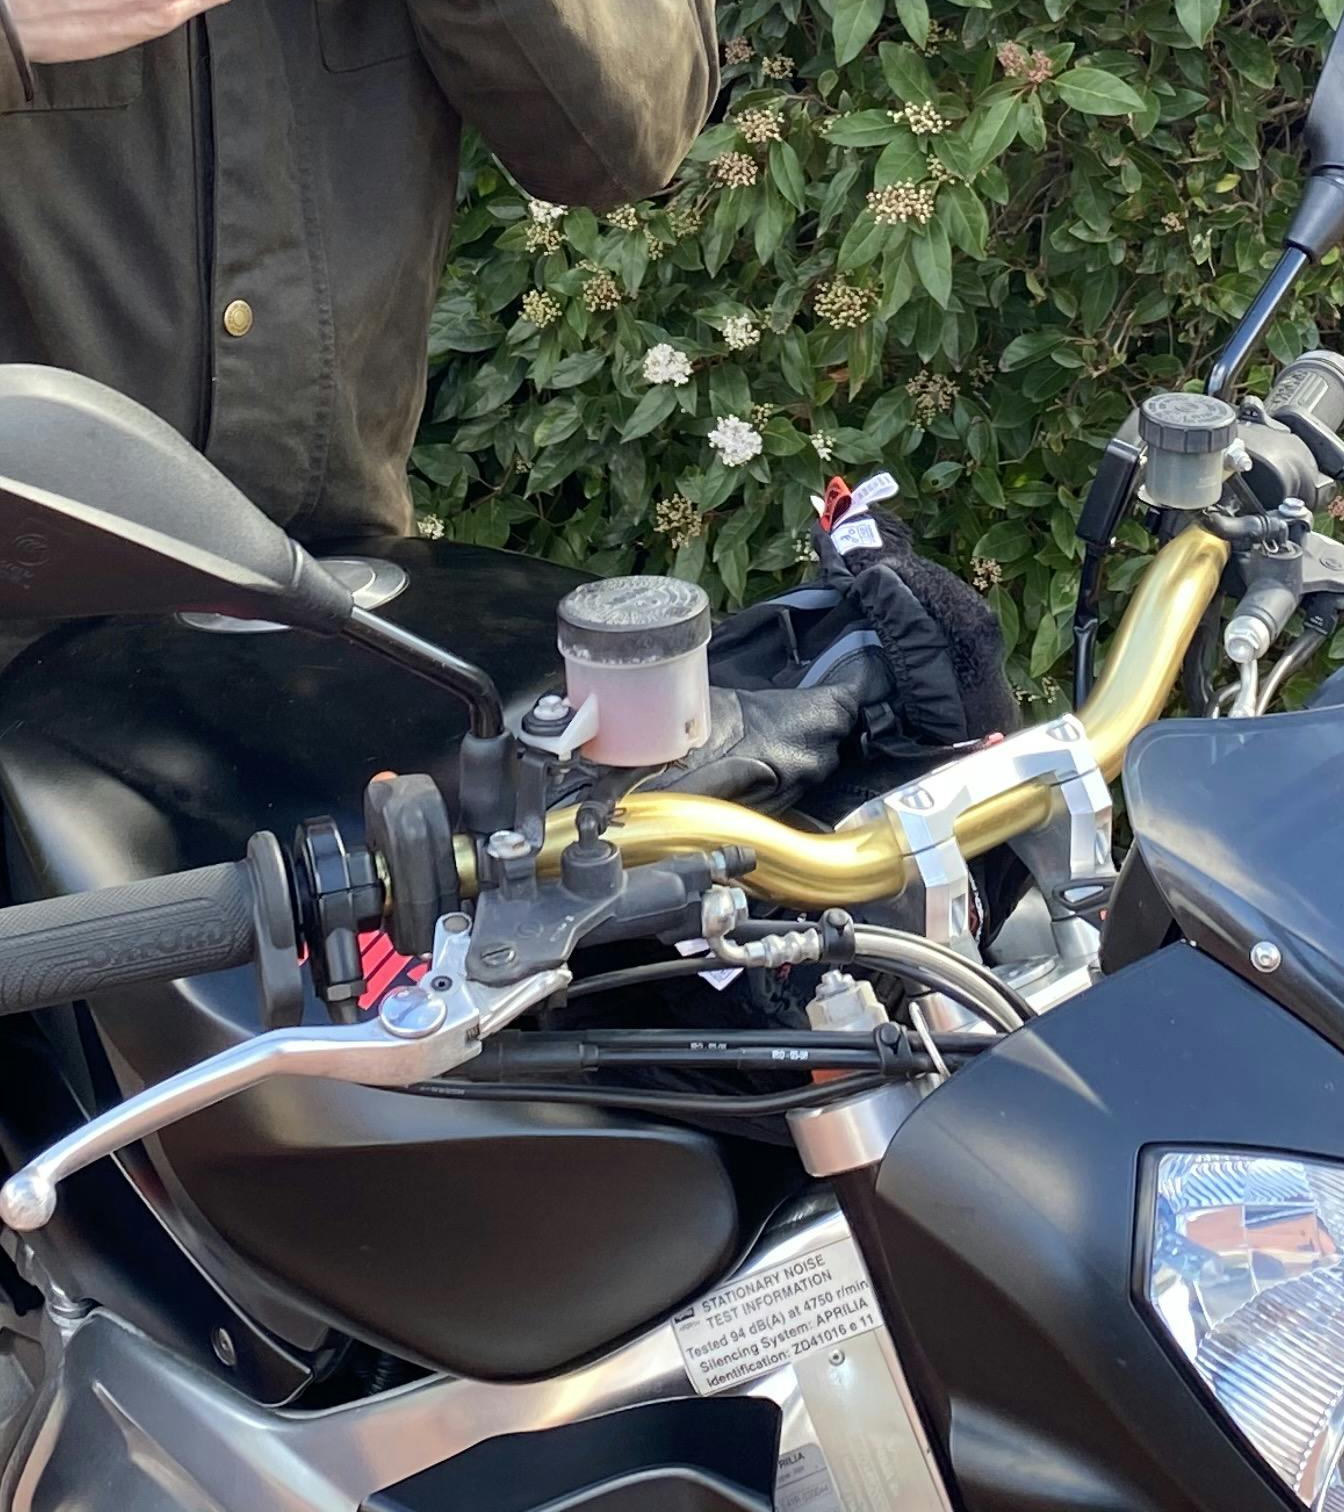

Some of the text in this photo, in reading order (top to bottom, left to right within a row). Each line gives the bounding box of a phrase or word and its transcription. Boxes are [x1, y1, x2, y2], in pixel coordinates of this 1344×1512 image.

[686, 1279, 870, 1361] Tested 94 dB(A) at 4750 r/min
[701, 1254, 826, 1314] STATIONARY NOISE
[706, 1269, 832, 1329] TEST INFORMATION
[699, 1297, 869, 1374] Silencing System: APRILIA
[707, 1351, 791, 1388] Identification:
[794, 1326, 847, 1355] ZD41016
[860, 1313, 875, 1327] 11
